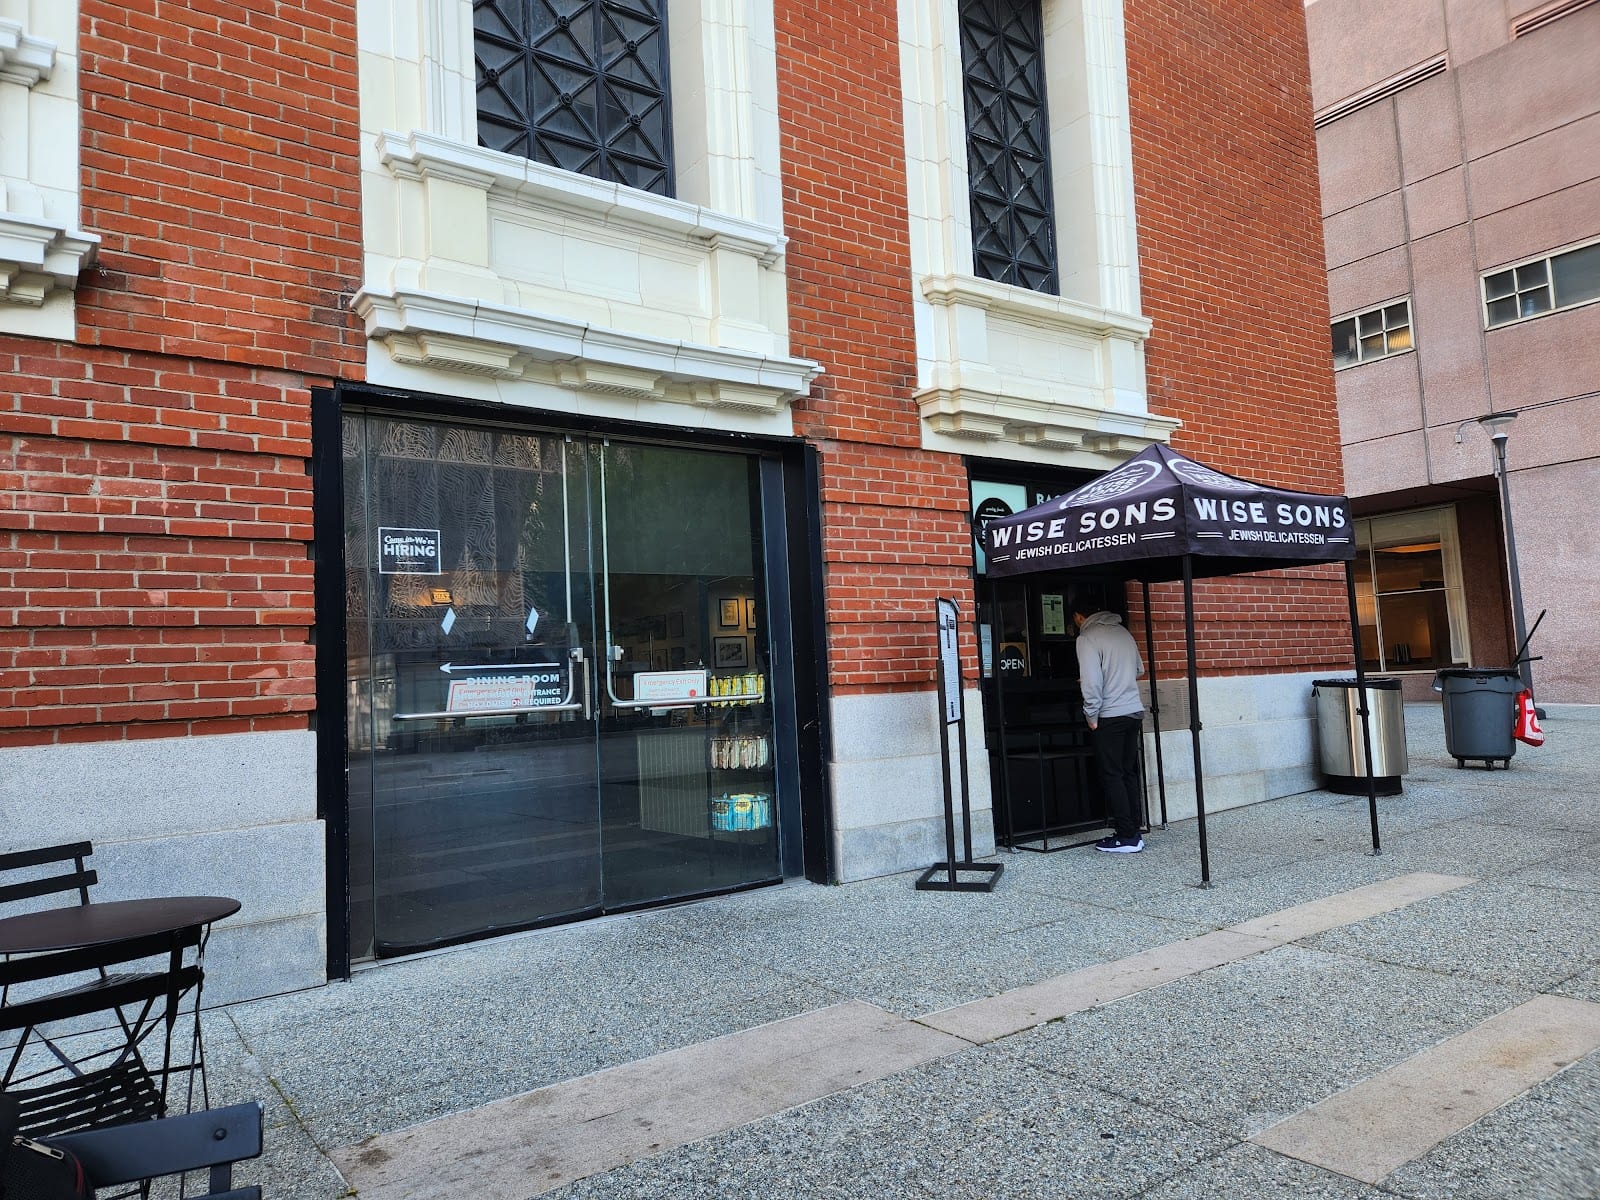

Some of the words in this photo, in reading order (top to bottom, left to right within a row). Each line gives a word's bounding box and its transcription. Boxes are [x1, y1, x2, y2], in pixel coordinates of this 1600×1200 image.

[1036, 493, 1061, 506] BA
[1194, 498, 1267, 524] WISE
[1277, 504, 1345, 528] SONS
[992, 517, 1066, 548] WISE
[1080, 498, 1176, 533] SONS
[384, 535, 404, 544] Come
[1228, 530, 1263, 542] JEWISH
[1264, 531, 1324, 545] DELICATESSEN
[384, 544, 436, 557] HIRING
[1015, 546, 1052, 560] JEWISH
[1054, 533, 1136, 555] DELICATESSEN
[1000, 658, 1025, 670] OPEN
[466, 675, 516, 686] DINING
[522, 674, 560, 684] ROOM
